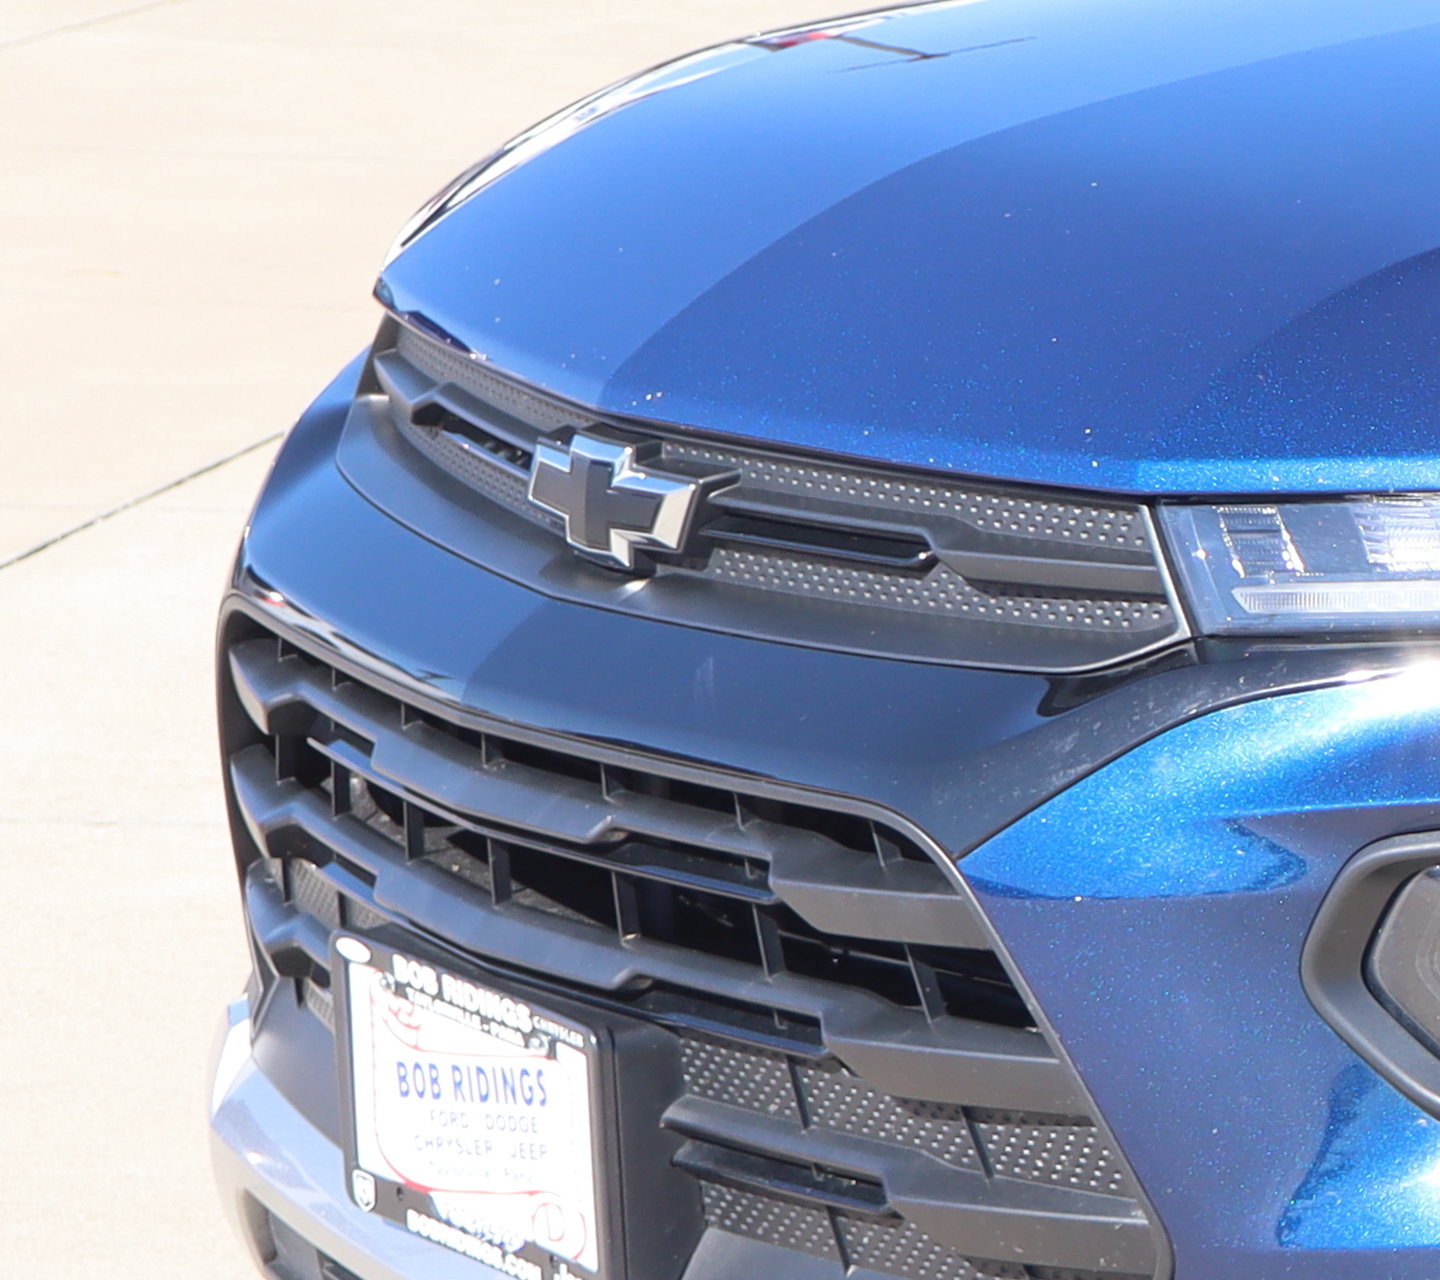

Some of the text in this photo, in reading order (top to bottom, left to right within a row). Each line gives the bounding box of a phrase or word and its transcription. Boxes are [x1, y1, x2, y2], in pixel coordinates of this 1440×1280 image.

[393, 953, 533, 1034] BOB RIDINGS
[396, 1060, 549, 1107] BOB RIDINGS
[484, 1112, 540, 1134] DODGE
